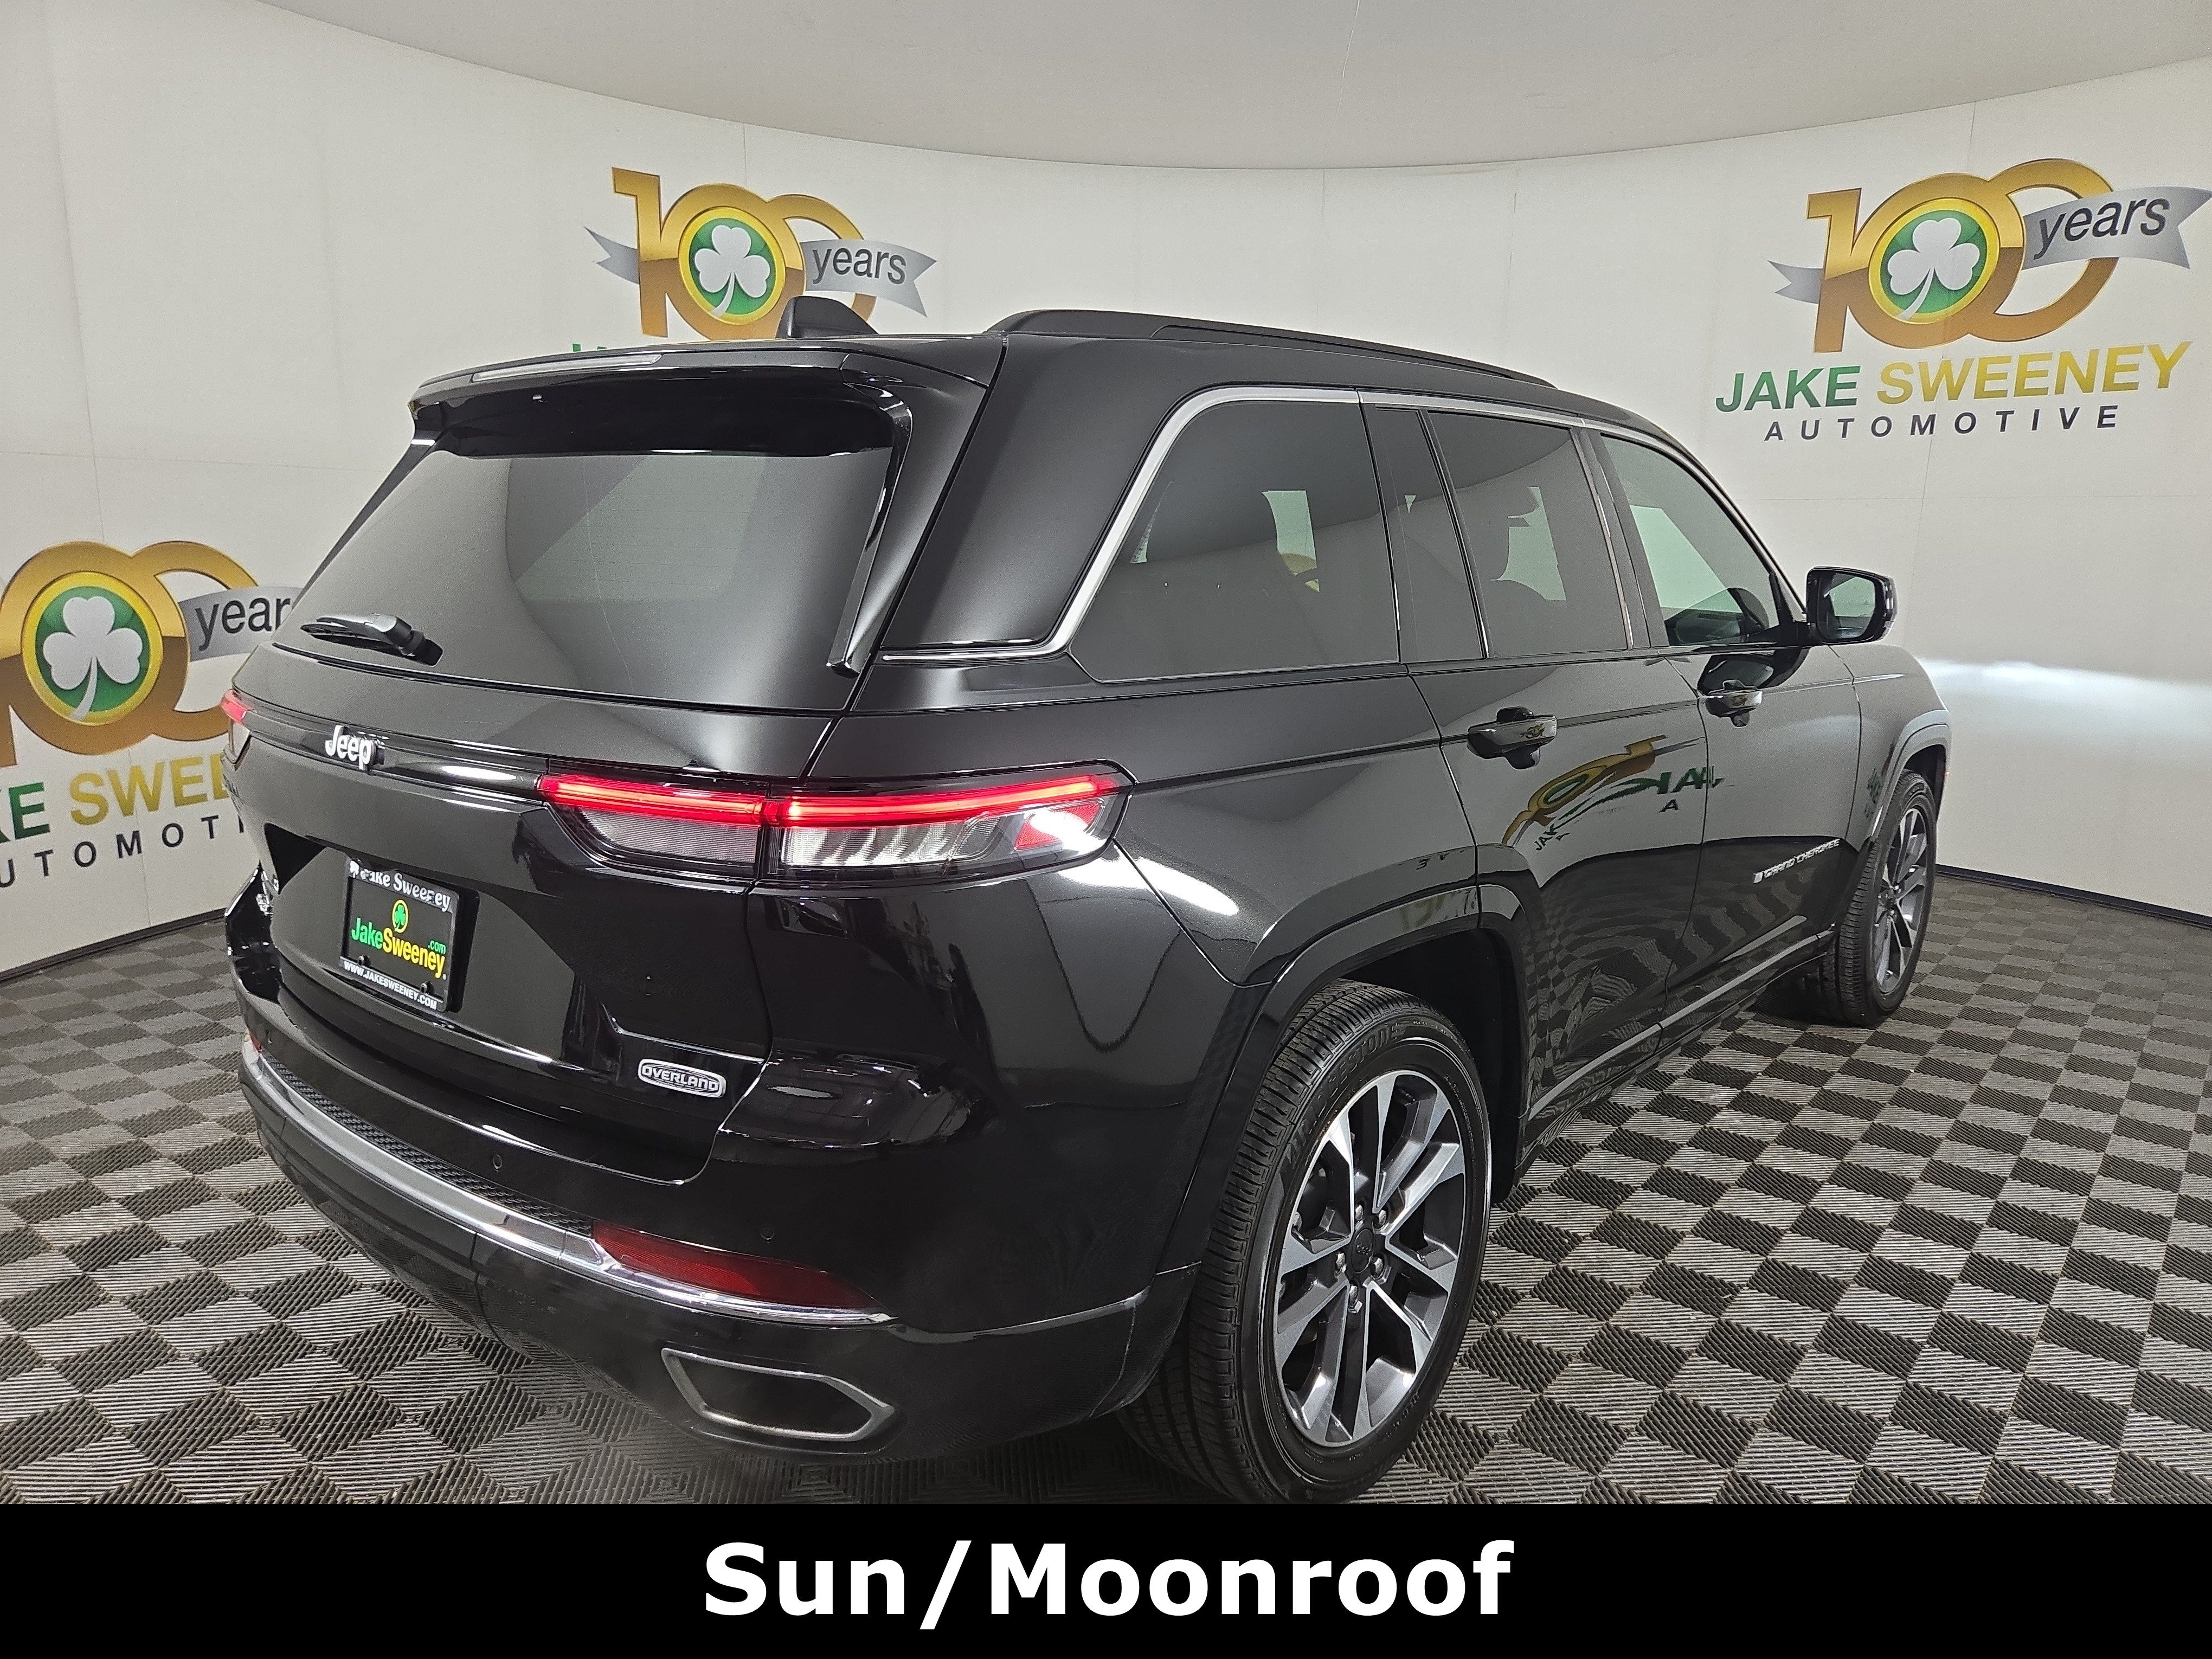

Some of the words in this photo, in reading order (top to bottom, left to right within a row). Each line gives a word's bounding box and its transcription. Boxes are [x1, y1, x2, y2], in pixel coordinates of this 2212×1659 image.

[2034, 198, 2170, 260] years
[812, 247, 907, 285] years
[1715, 365, 1861, 413] JAKE
[1876, 340, 2193, 405] SWEENEY
[1764, 404, 2119, 441] AUTOMOTIVE
[325, 725, 373, 770] Jeep
[344, 961, 438, 1011] WWW.JAKESWEENEY.COM
[641, 1065, 719, 1091] OVERLAND
